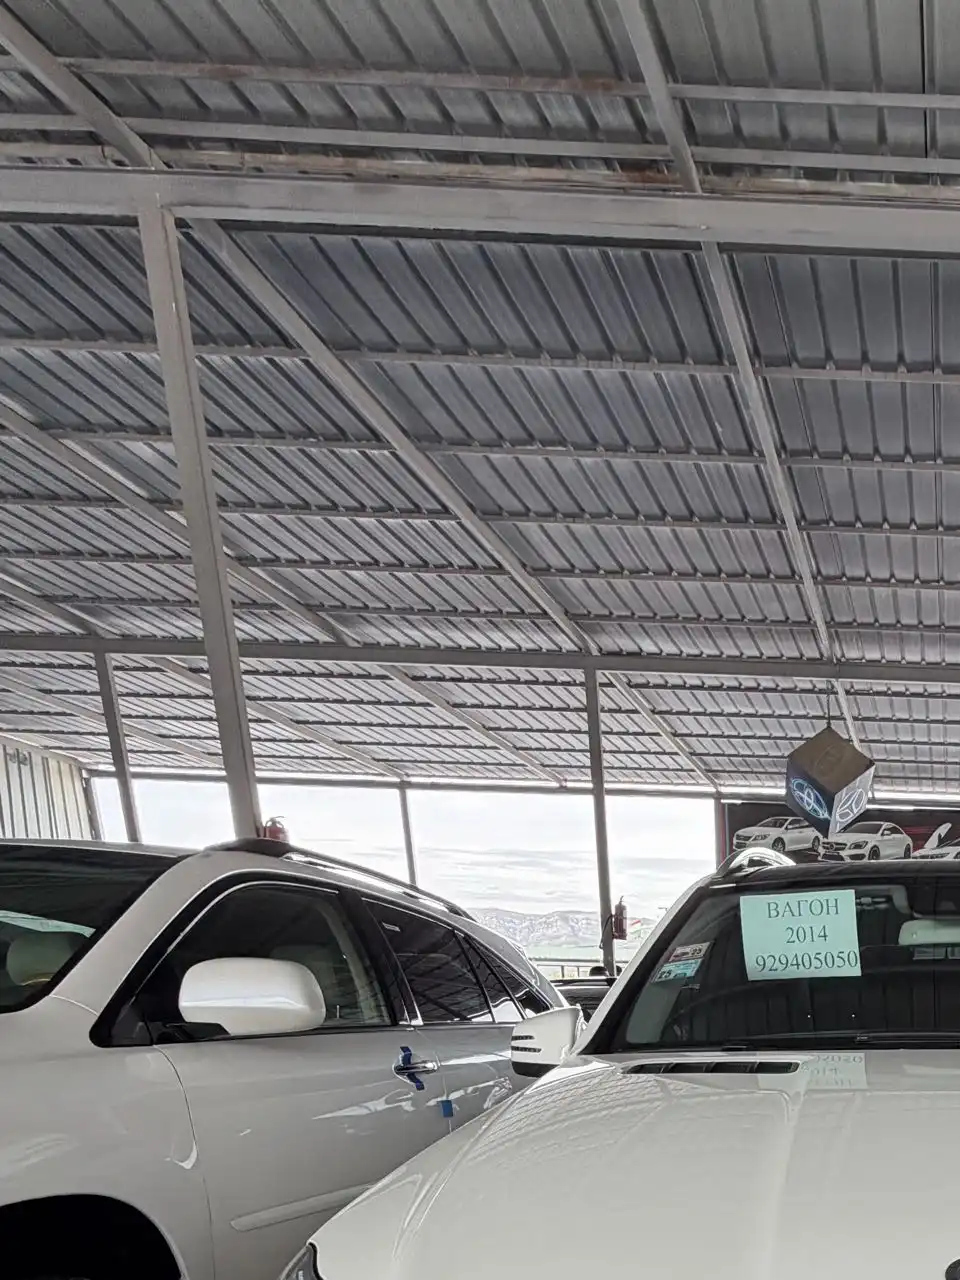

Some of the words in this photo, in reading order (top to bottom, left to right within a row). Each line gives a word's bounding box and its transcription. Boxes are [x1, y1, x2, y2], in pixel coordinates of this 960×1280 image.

[766, 898, 840, 919] ВАГОН
[785, 924, 829, 944] 2014
[755, 950, 859, 973] 929405050
